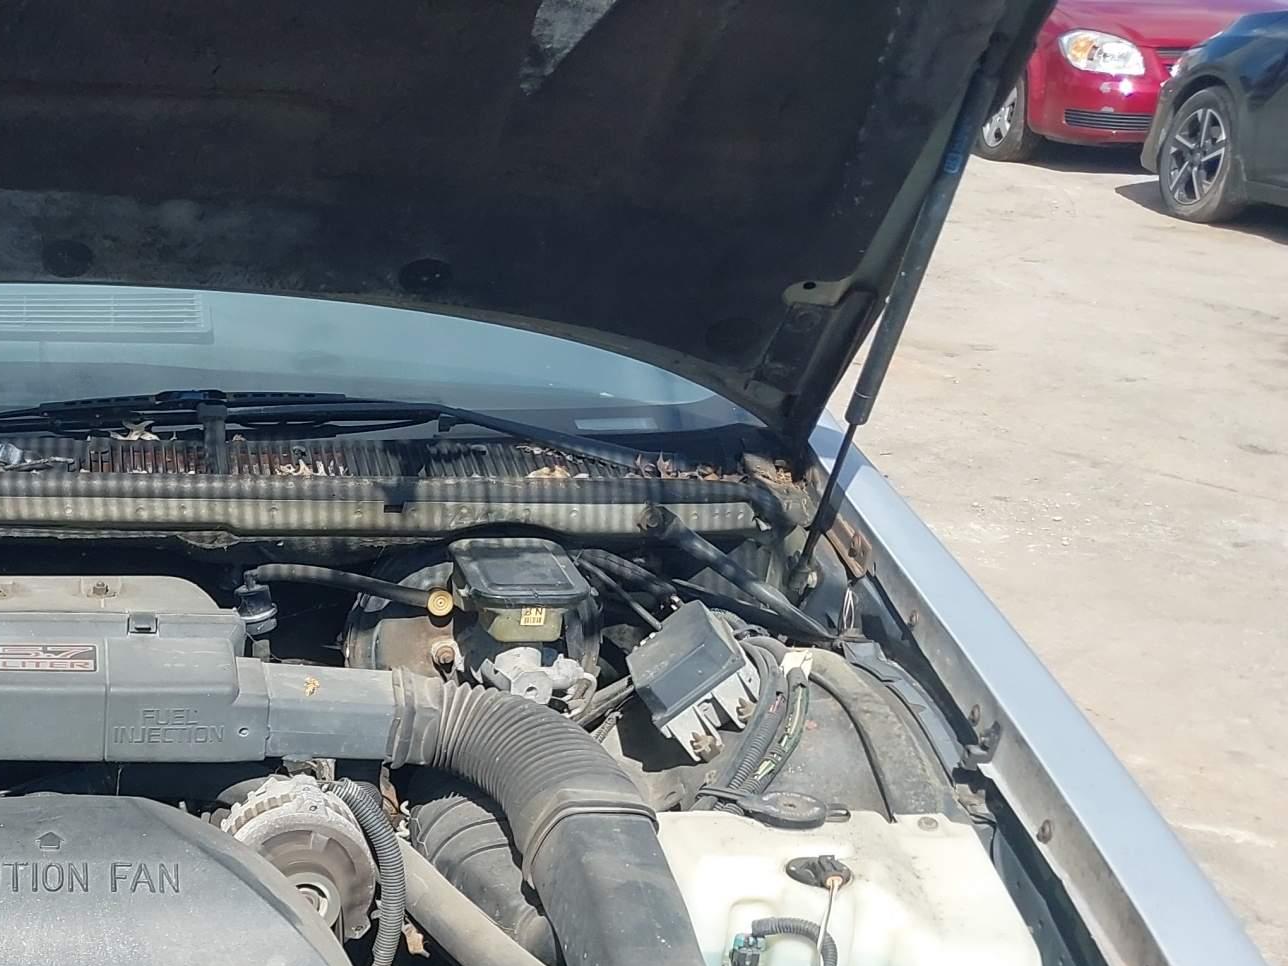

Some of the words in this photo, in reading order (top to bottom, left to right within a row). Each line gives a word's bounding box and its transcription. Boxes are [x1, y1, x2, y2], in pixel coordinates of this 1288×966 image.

[141, 708, 199, 726] FUEL
[112, 725, 225, 744] INJECTION
[111, 861, 181, 894] FAN
